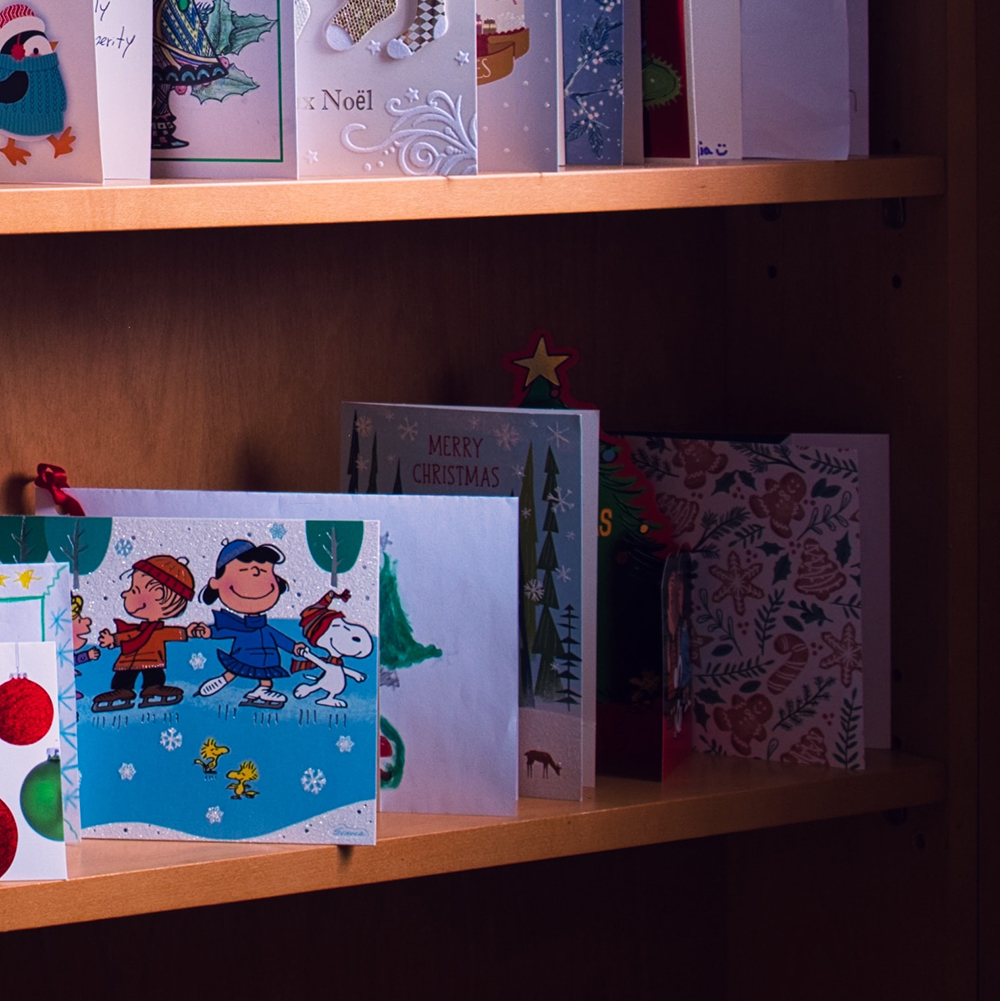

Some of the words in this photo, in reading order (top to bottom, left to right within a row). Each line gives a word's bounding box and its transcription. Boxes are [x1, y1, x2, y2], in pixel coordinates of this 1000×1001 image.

[321, 88, 374, 111] Noël
[428, 434, 484, 458] MERRY
[412, 462, 500, 488] CHRISTMAS
